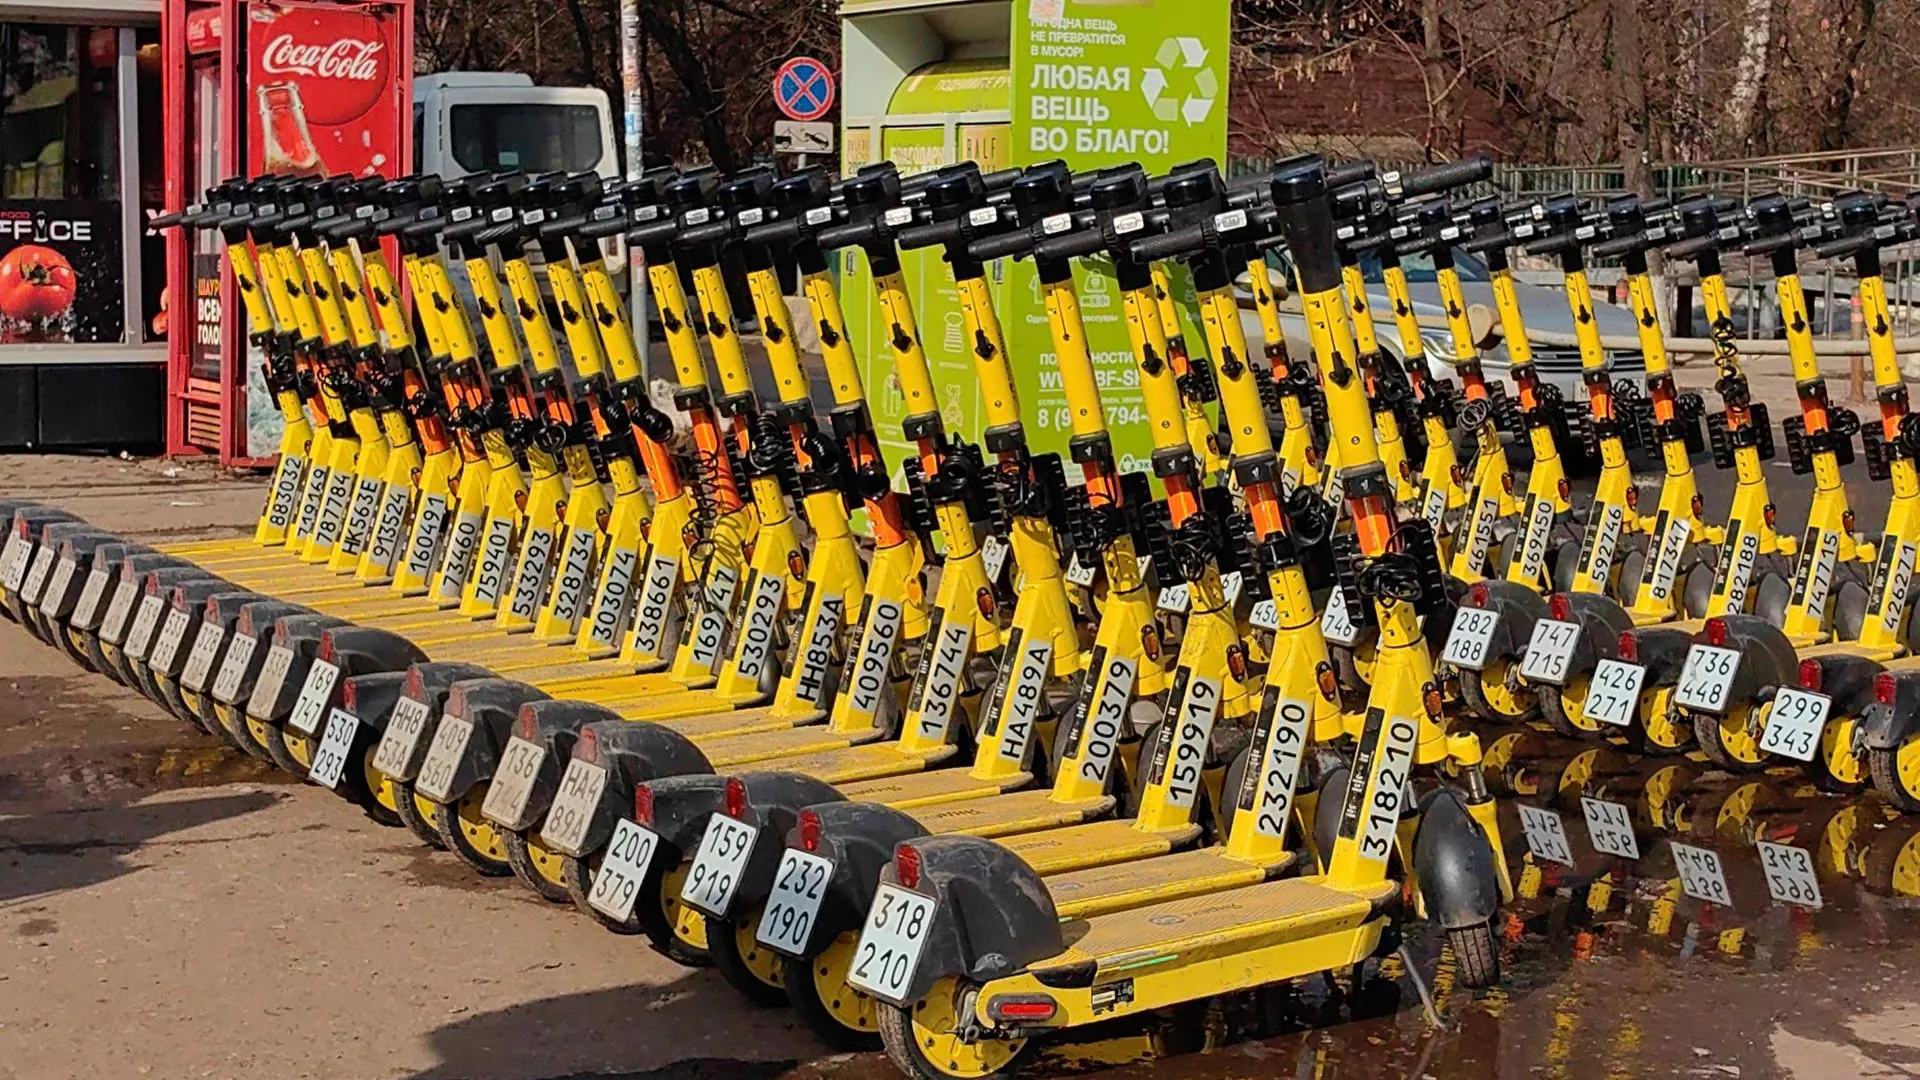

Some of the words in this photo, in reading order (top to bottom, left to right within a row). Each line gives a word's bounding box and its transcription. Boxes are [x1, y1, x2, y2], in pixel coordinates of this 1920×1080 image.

[1031, 31, 1046, 42] НЕ
[1049, 32, 1126, 45] ПРЕВРАТИТСЯ
[1084, 19, 1118, 32] ВЕЩЬ
[262, 35, 384, 80] Coca-Cola
[1031, 45, 1039, 56] В
[1042, 46, 1084, 58] МУСОР!
[1030, 64, 1130, 91] ЛЮБАЯ
[1031, 95, 1110, 126] ВЕЩЬ
[1030, 127, 1068, 152] ВО
[1076, 128, 1169, 154] БЛАГО!
[198, 279, 221, 296] ШАУР
[198, 325, 221, 345] ГОЛО
[1040, 352, 1133, 365] ПОНОСТИ
[1038, 408, 1049, 428] 8
[1107, 406, 1148, 426] 794-
[270, 457, 301, 526] 883032
[316, 474, 350, 543] 787784
[342, 479, 378, 556] HK563E
[374, 493, 406, 559] 913524
[410, 497, 445, 573] 160491
[1469, 500, 1497, 572] 461551
[443, 522, 475, 587] 73460
[476, 520, 511, 600] 759401
[1523, 502, 1552, 577] 369450
[1592, 508, 1622, 582] 592746
[1653, 520, 1688, 599] 817347
[512, 530, 550, 616] 533293
[555, 532, 594, 620] 328734
[1727, 536, 1757, 614] 282188
[1808, 533, 1839, 615] 747715
[1885, 544, 1916, 630] 426271
[593, 553, 634, 641] 303074
[635, 559, 675, 651] 338661
[197, 626, 221, 652] 328
[739, 577, 781, 676] 530293
[1324, 614, 1352, 637] 746
[1456, 612, 1492, 636] 282
[1537, 624, 1575, 648] 747
[228, 637, 253, 664] 303
[796, 599, 843, 702] HH853A
[854, 604, 898, 710] 409560
[1450, 639, 1483, 661] 188
[1527, 651, 1565, 676] 715
[1694, 650, 1733, 676] 736
[309, 662, 335, 694] 169
[921, 628, 967, 734] 136744
[1599, 664, 1637, 691] 426
[1682, 681, 1723, 705] 448
[293, 696, 322, 734] 747
[1001, 647, 1049, 758] HA489A
[1082, 661, 1132, 781] 200379
[1588, 693, 1630, 722] 271
[1776, 694, 1823, 724] 299
[326, 714, 355, 747] 530
[438, 722, 468, 754] 409
[1170, 682, 1215, 801] 159919
[1767, 724, 1814, 755] 343
[313, 748, 342, 781] 293
[422, 759, 452, 791] 560
[506, 744, 537, 778] 136
[1259, 704, 1305, 834] 232190
[1363, 722, 1414, 856] 318210
[611, 827, 651, 868] 200
[708, 821, 749, 863] 159
[595, 867, 635, 908] 379
[692, 863, 732, 906] 919
[778, 856, 826, 900] 232
[767, 903, 810, 946] 190
[874, 893, 926, 940] 318
[855, 942, 909, 990] 210
